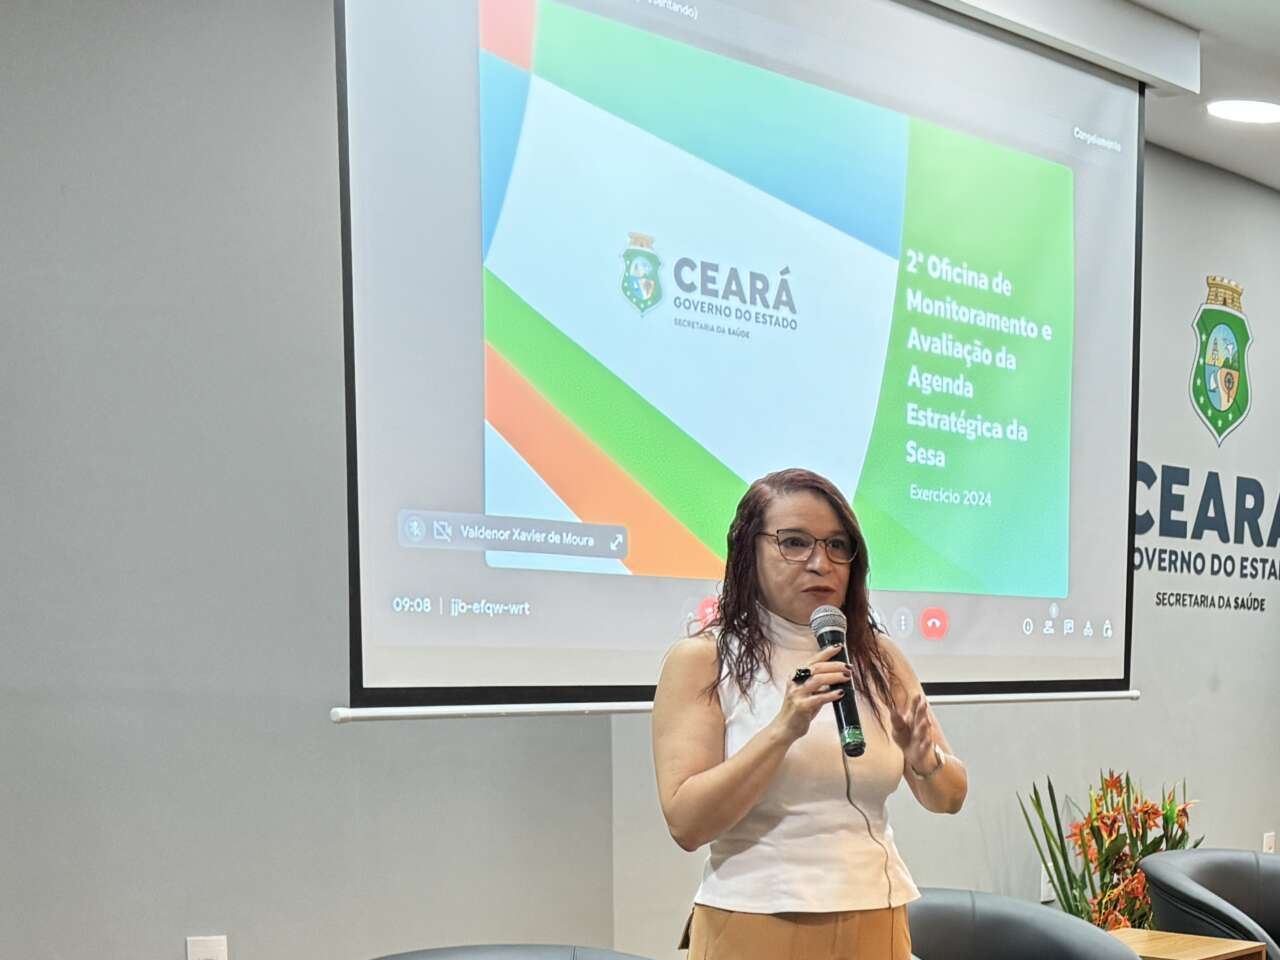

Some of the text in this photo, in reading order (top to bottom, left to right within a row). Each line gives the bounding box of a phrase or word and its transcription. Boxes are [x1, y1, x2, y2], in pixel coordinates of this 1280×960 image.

[673, 257, 797, 314] CEARÁ
[927, 254, 989, 290] Oficina
[992, 271, 1012, 296] de
[673, 296, 798, 331] GOVERNO DO ESTADO
[673, 317, 751, 340] SECRETARIA DA SAÚDE
[906, 288, 1052, 341] Monitoramento e
[907, 327, 1017, 370] Avaliação da
[907, 364, 974, 398] Agenda
[906, 402, 1028, 441] Estratégica da
[906, 440, 945, 467] Sesa
[910, 483, 992, 507] Exercício 2024
[460, 525, 595, 547] Valdenor Xavier de Moura
[1133, 547, 1206, 576] OVERNO
[1211, 554, 1236, 578] DO
[392, 597, 432, 613] 09:08
[1155, 591, 1266, 612] SECRETARIA DA SAÚDE
